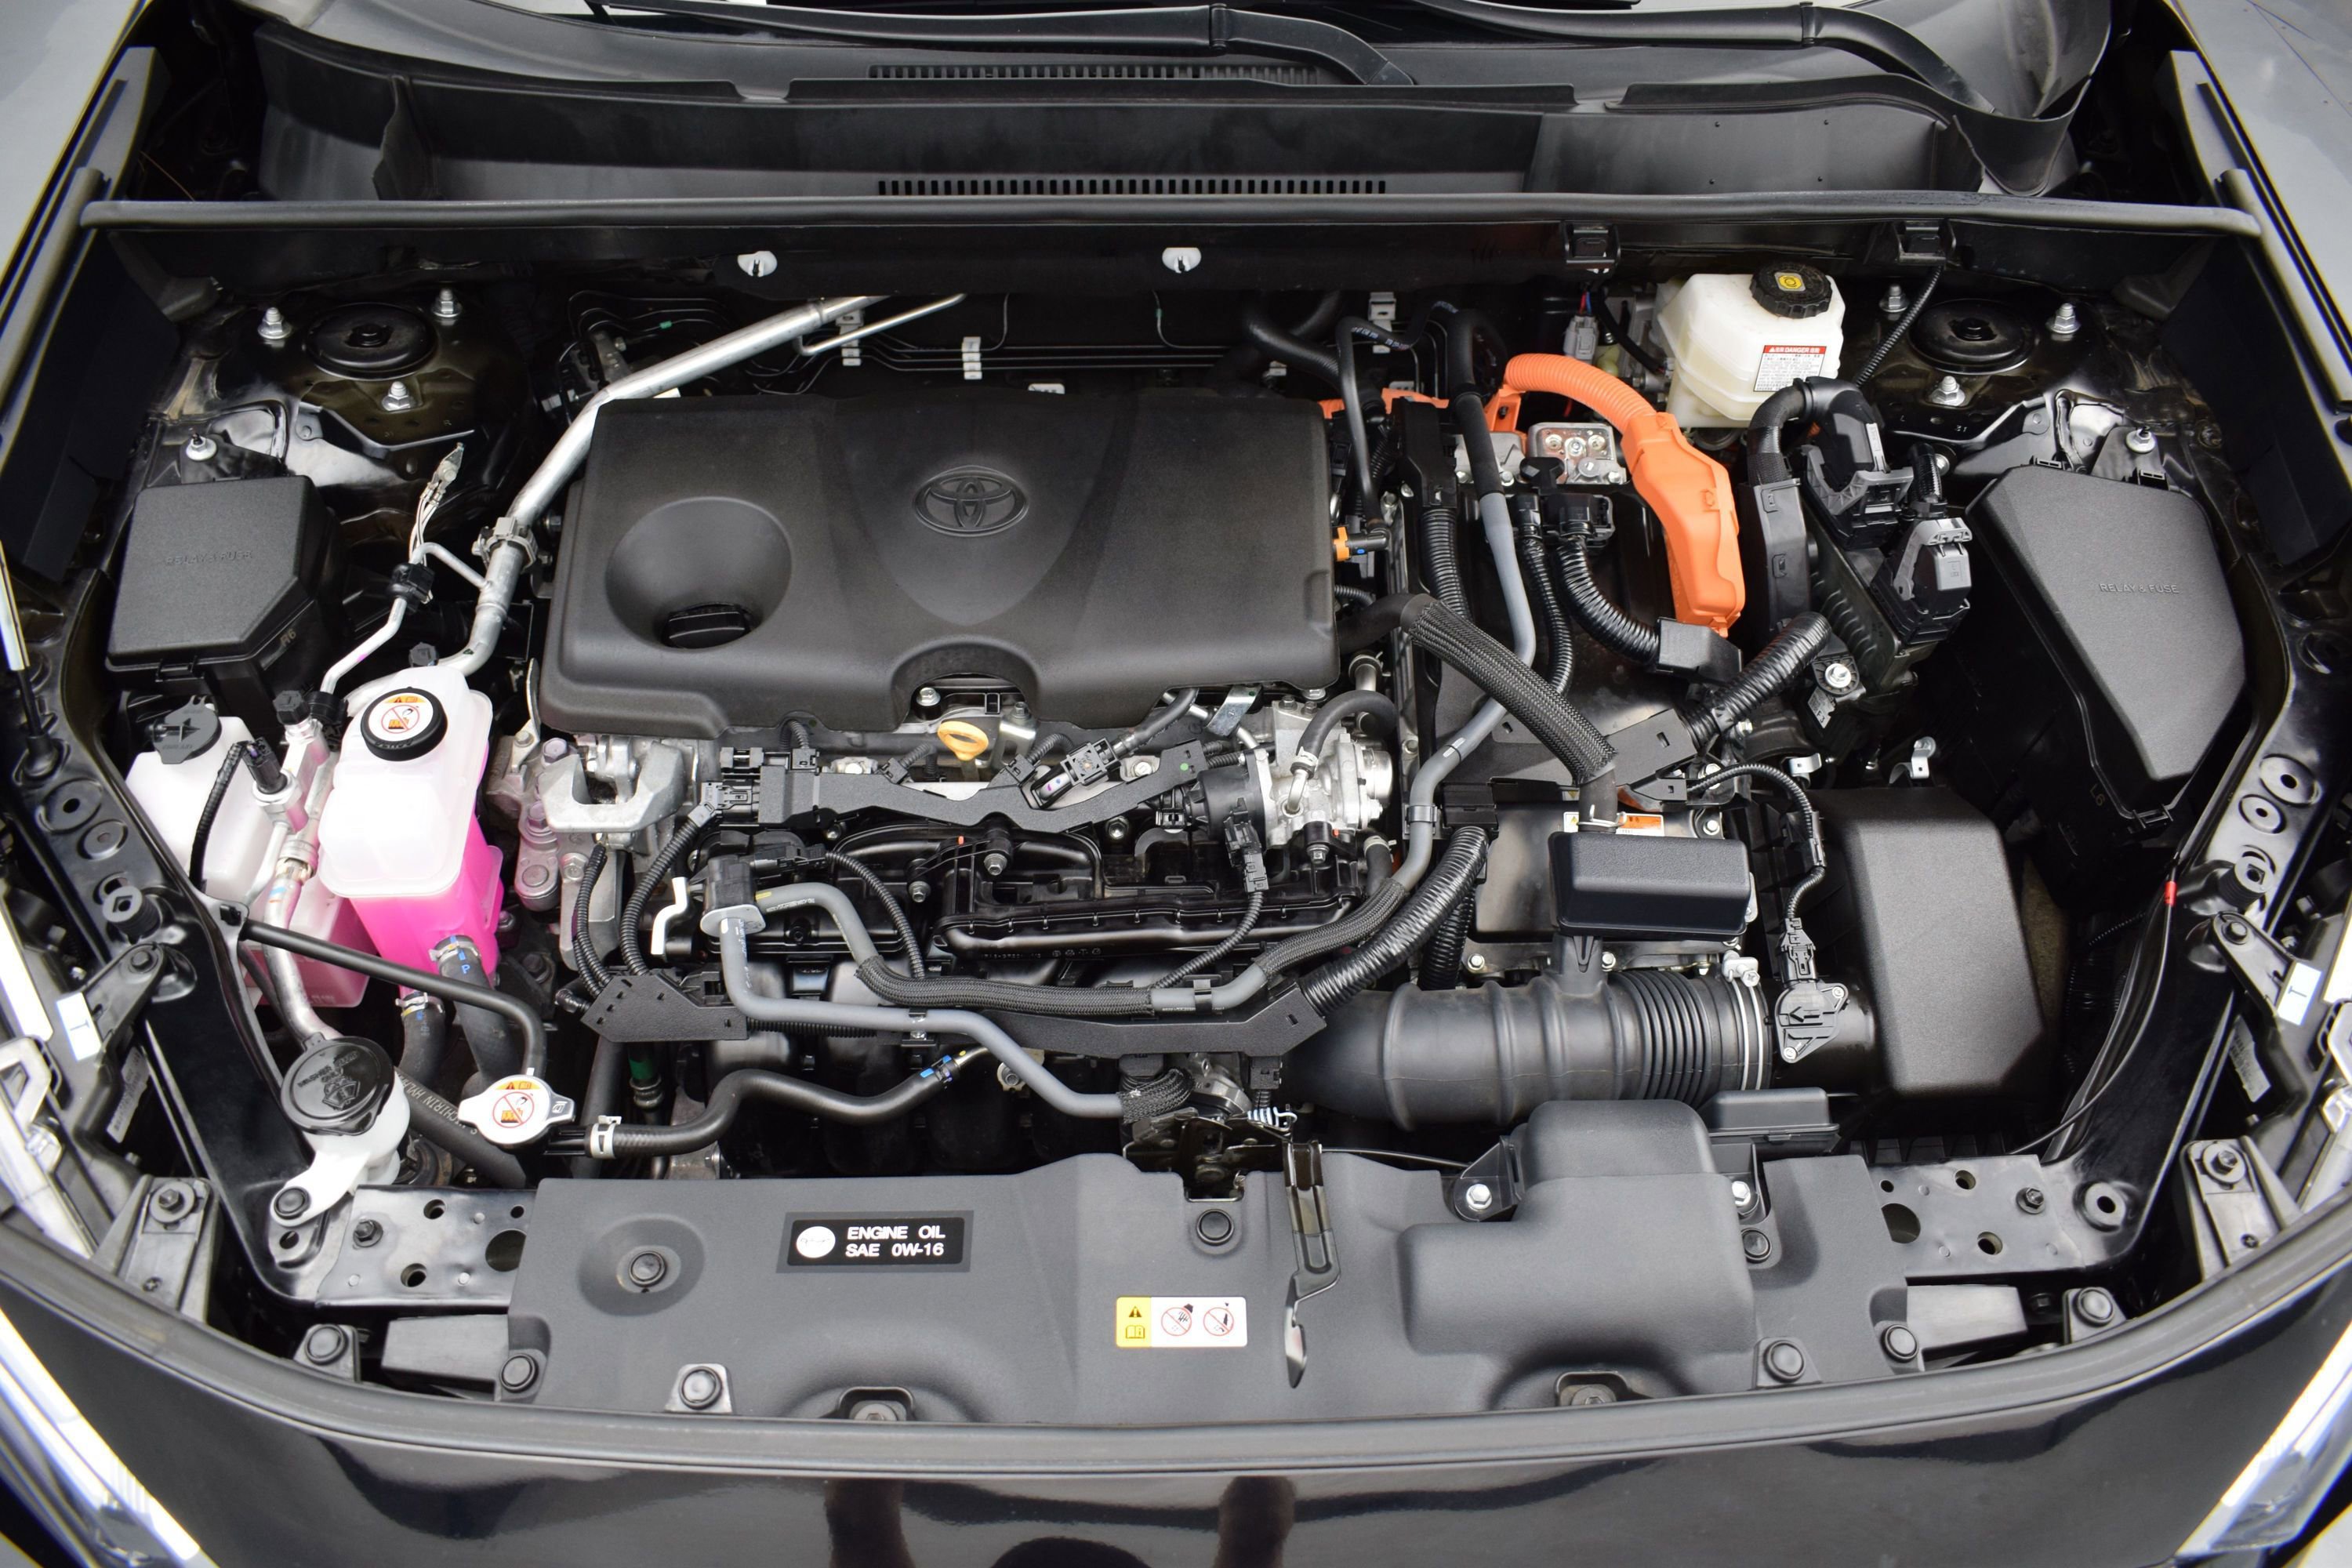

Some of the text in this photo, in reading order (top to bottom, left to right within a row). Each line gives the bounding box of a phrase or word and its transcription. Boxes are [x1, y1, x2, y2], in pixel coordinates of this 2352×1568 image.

[2099, 583, 2135, 593] RELAY
[2148, 584, 2180, 593] FUSE
[462, 964, 470, 974] P
[2288, 985, 2307, 998] T
[70, 1018, 90, 1032] T
[847, 1225, 946, 1240] ENGINE OIL
[845, 1243, 945, 1257] SAE 0W-16
